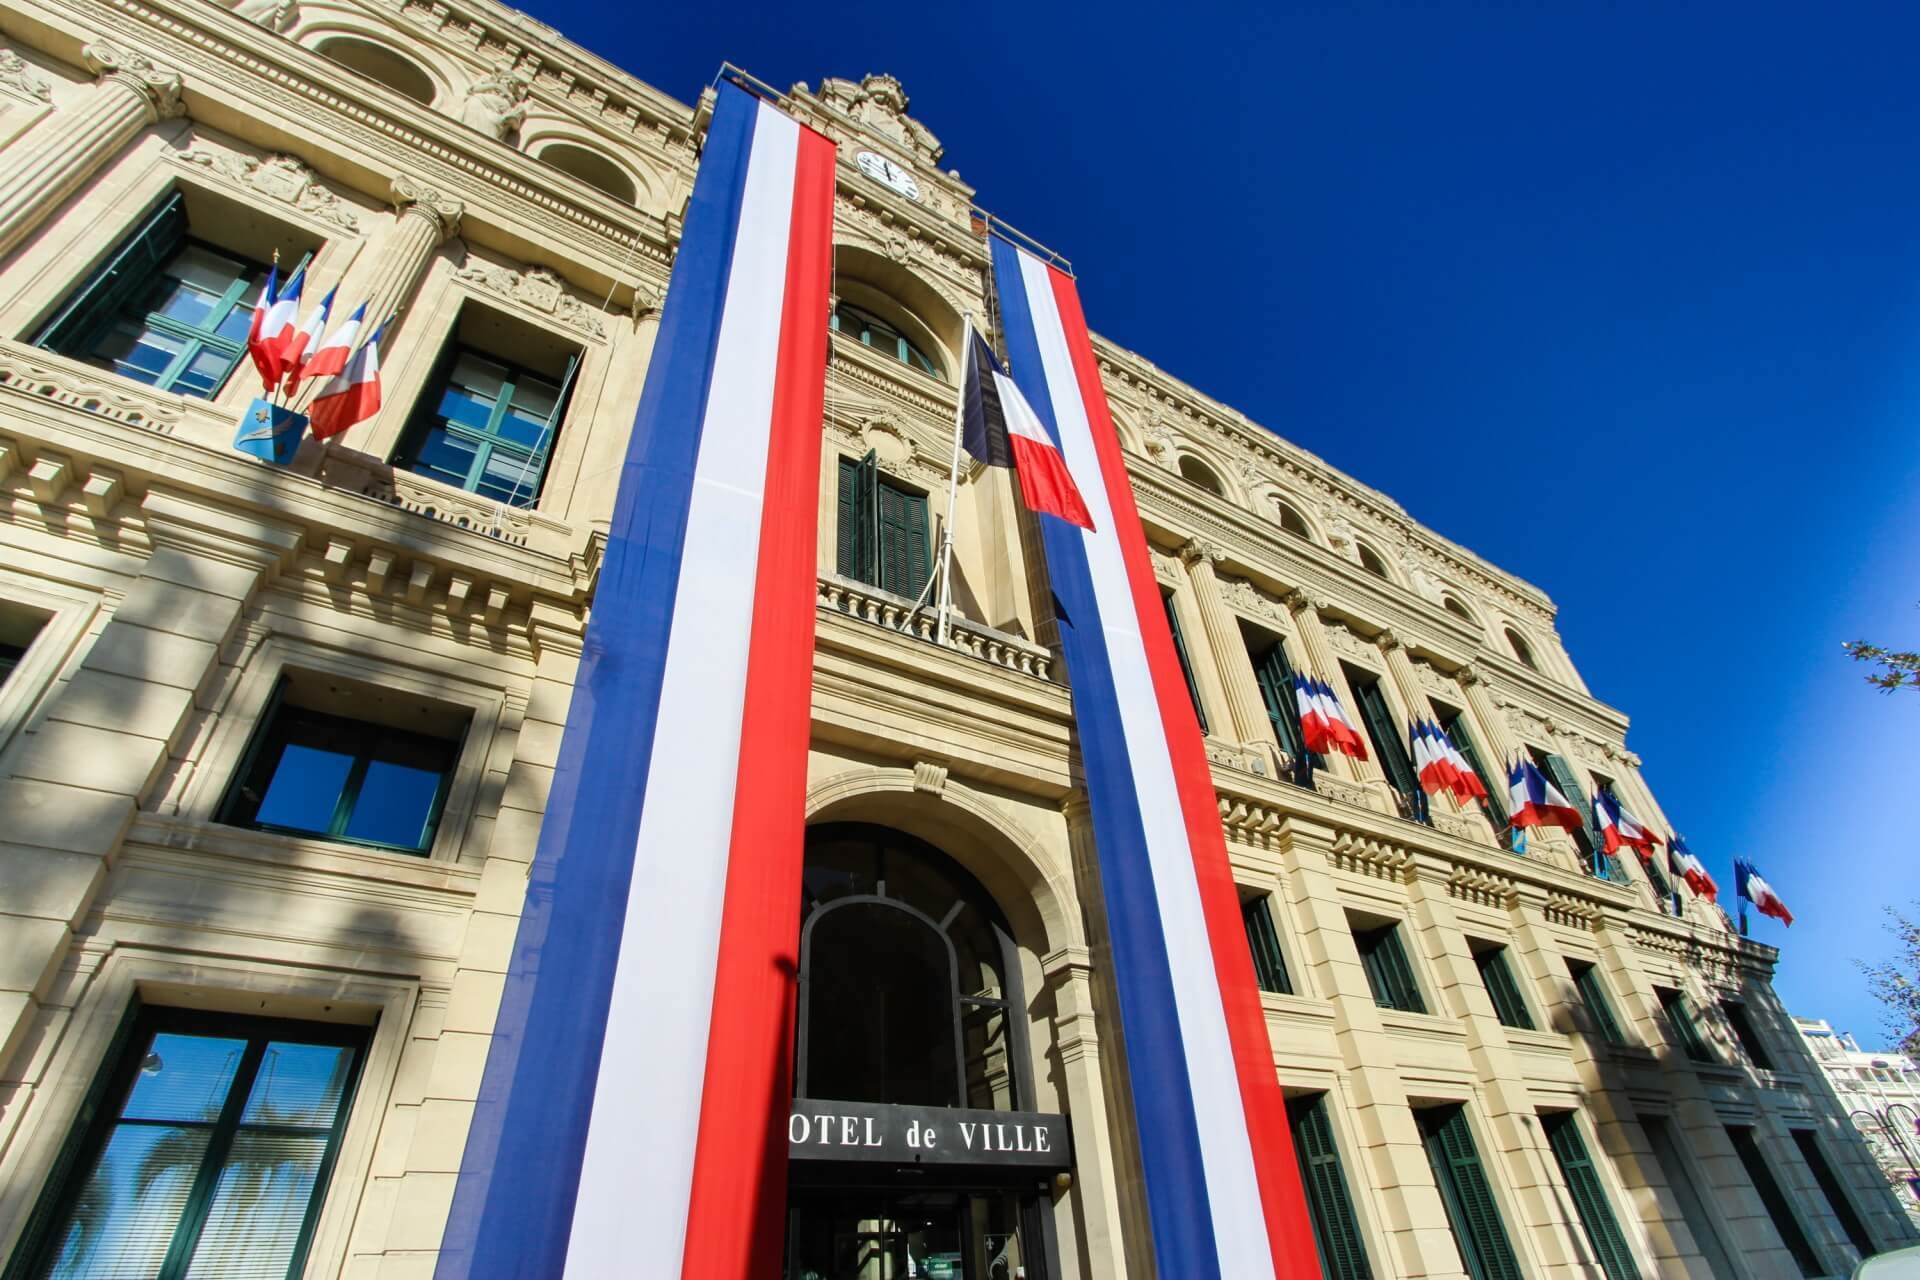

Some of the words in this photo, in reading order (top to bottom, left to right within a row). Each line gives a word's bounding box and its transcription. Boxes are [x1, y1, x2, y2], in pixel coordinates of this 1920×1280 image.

[788, 1113, 882, 1146] OTEL
[906, 1120, 937, 1149] de
[959, 1122, 1051, 1152] VILLE
